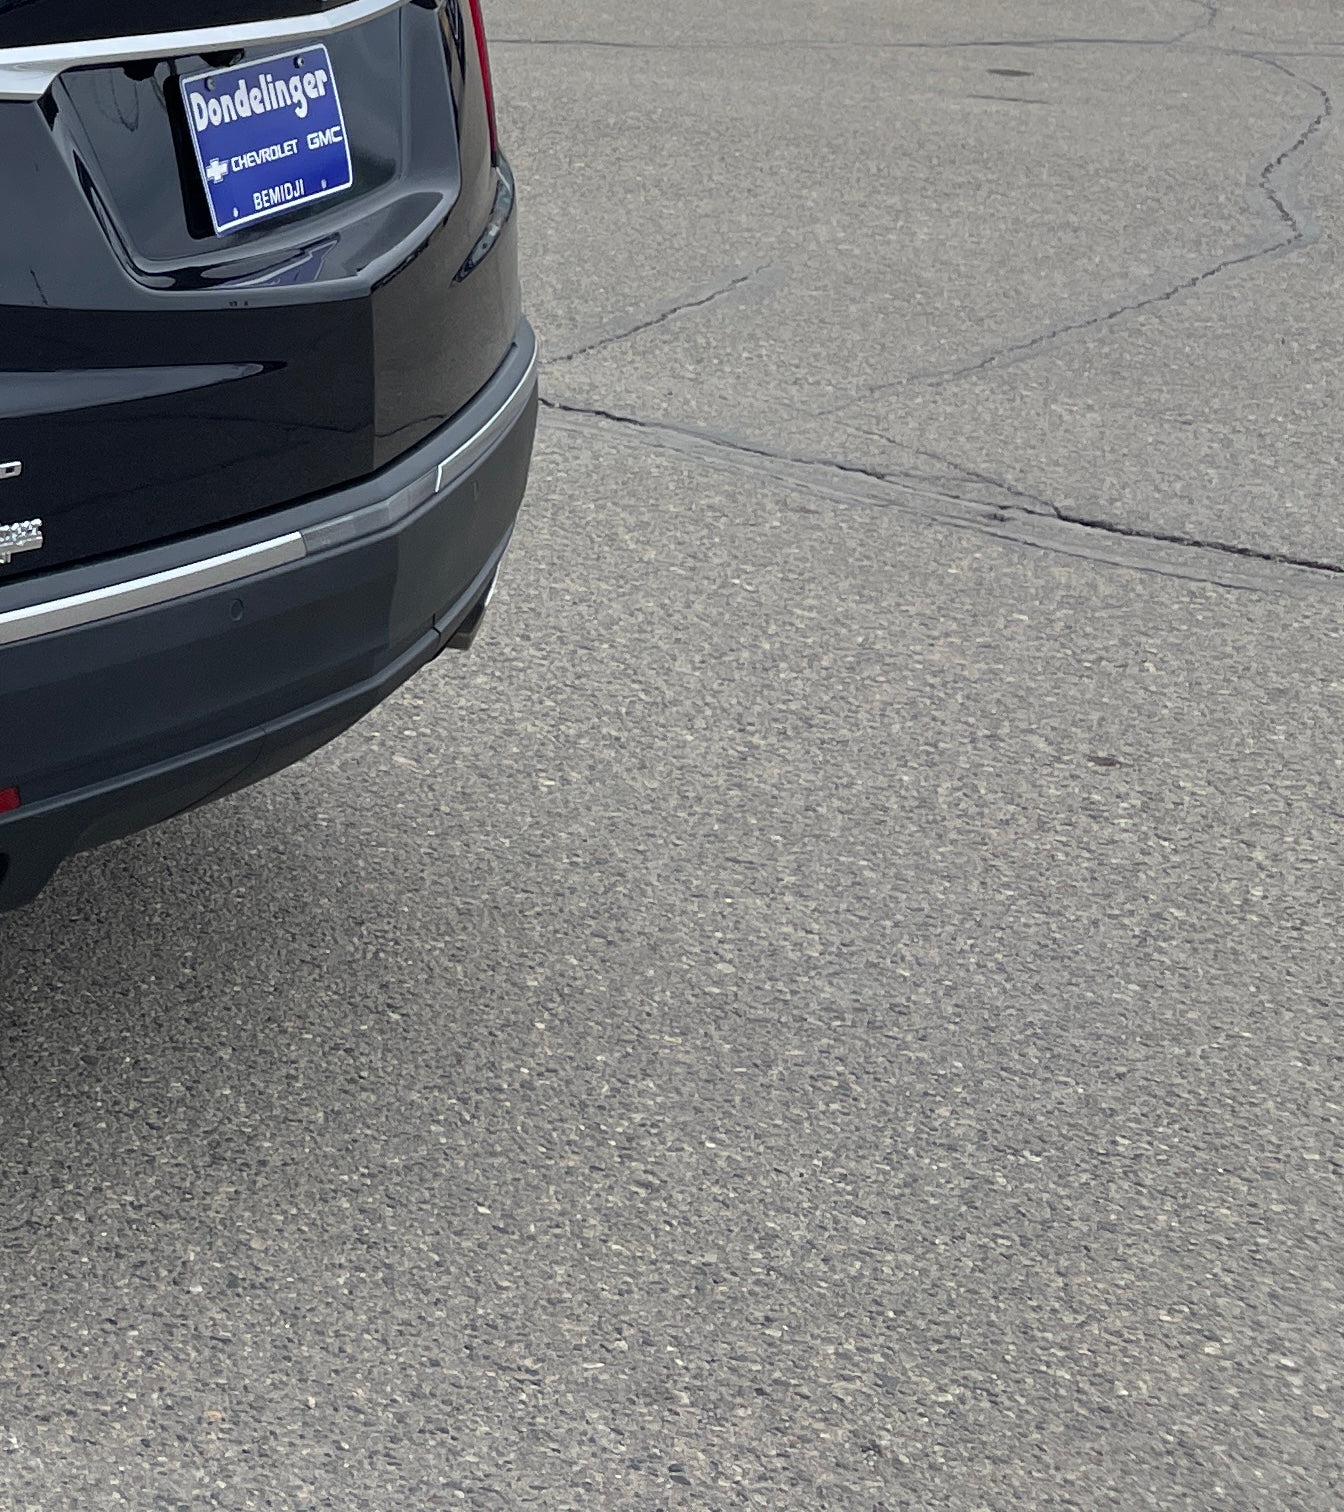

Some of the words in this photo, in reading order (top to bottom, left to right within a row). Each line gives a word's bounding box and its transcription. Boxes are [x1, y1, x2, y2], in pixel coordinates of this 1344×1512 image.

[189, 69, 328, 132] Dondelinger
[230, 139, 298, 172] CHEVROLET
[306, 126, 343, 150] GMC
[252, 178, 305, 211] BEMIDJI
